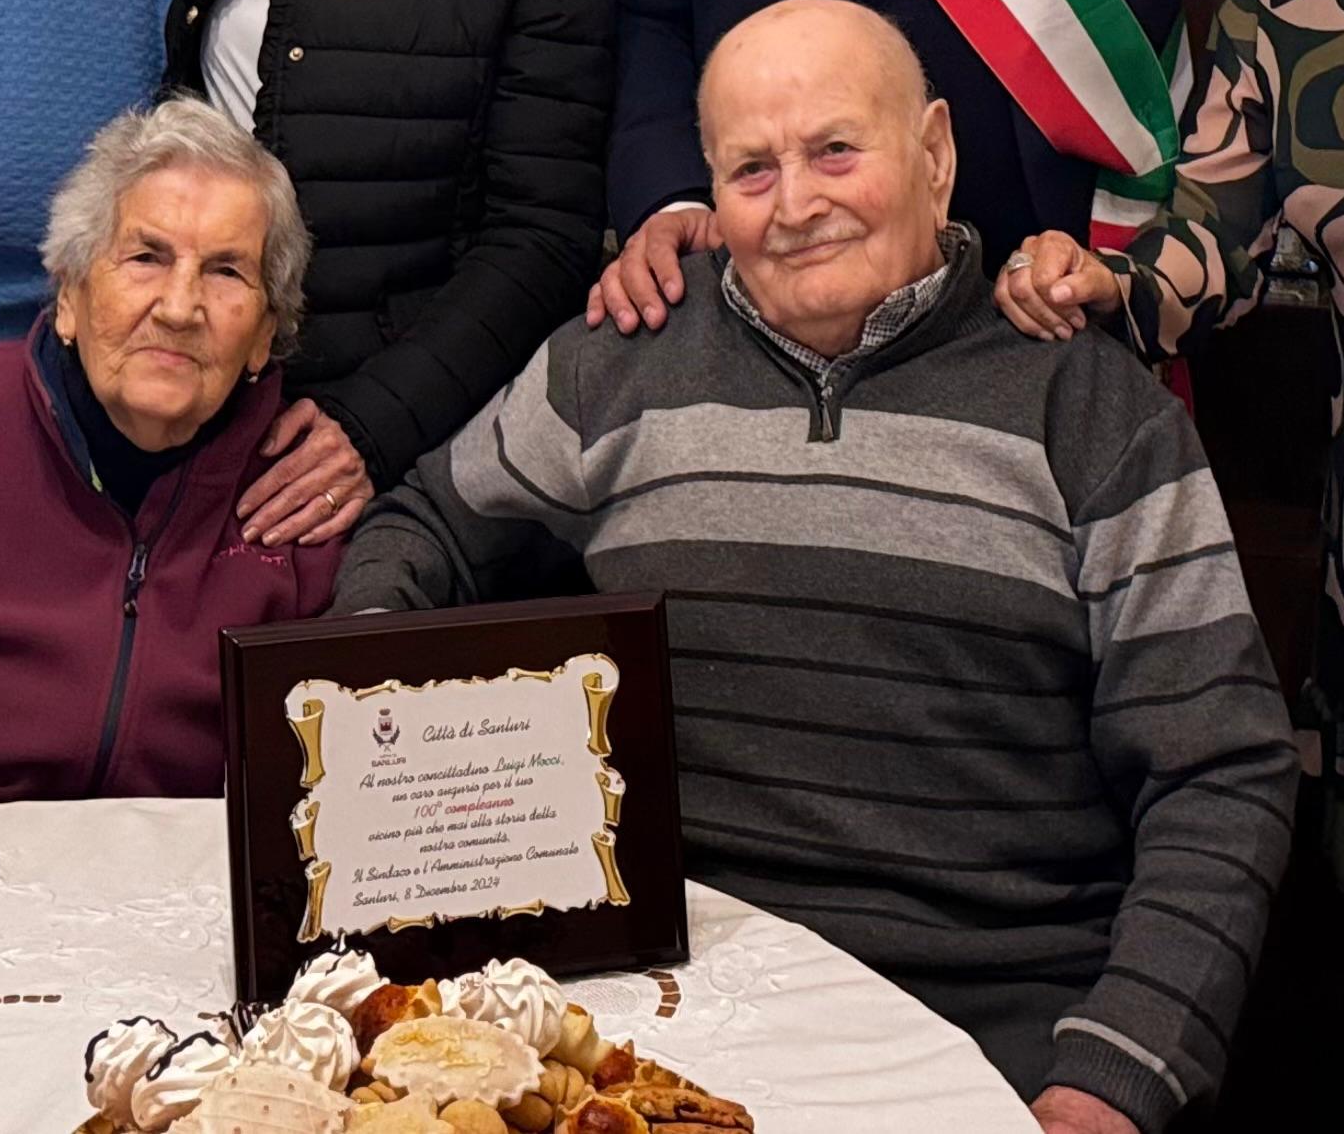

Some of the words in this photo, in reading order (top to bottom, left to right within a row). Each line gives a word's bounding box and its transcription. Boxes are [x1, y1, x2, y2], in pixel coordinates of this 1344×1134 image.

[422, 724, 457, 743] Città
[459, 720, 474, 738] di
[477, 715, 531, 736] Sanluri
[359, 772, 376, 790] Al
[377, 770, 415, 788] nostro
[417, 761, 490, 783] concittadino
[492, 756, 526, 775] Luigi
[392, 792, 408, 803] un
[410, 788, 435, 801] caro
[437, 782, 480, 800] augurio
[482, 780, 502, 796] per
[503, 773, 513, 788] il
[514, 776, 534, 787] suo
[444, 795, 515, 817] compleanno
[368, 829, 402, 842] vicino
[403, 824, 423, 843] più
[425, 819, 445, 835] che
[446, 819, 468, 832] mai
[470, 813, 493, 829] alla
[494, 811, 526, 827] storia
[529, 805, 558, 822] della
[419, 838, 456, 854] nostra
[352, 867, 364, 884] Il
[365, 863, 412, 883] Sindaco
[413, 866, 421, 876] e
[525, 840, 579, 861] Comunale
[352, 889, 400, 907] Sanluri,
[404, 886, 413, 901] 8
[414, 879, 468, 899] Dicembre
[469, 876, 501, 893] 2024
